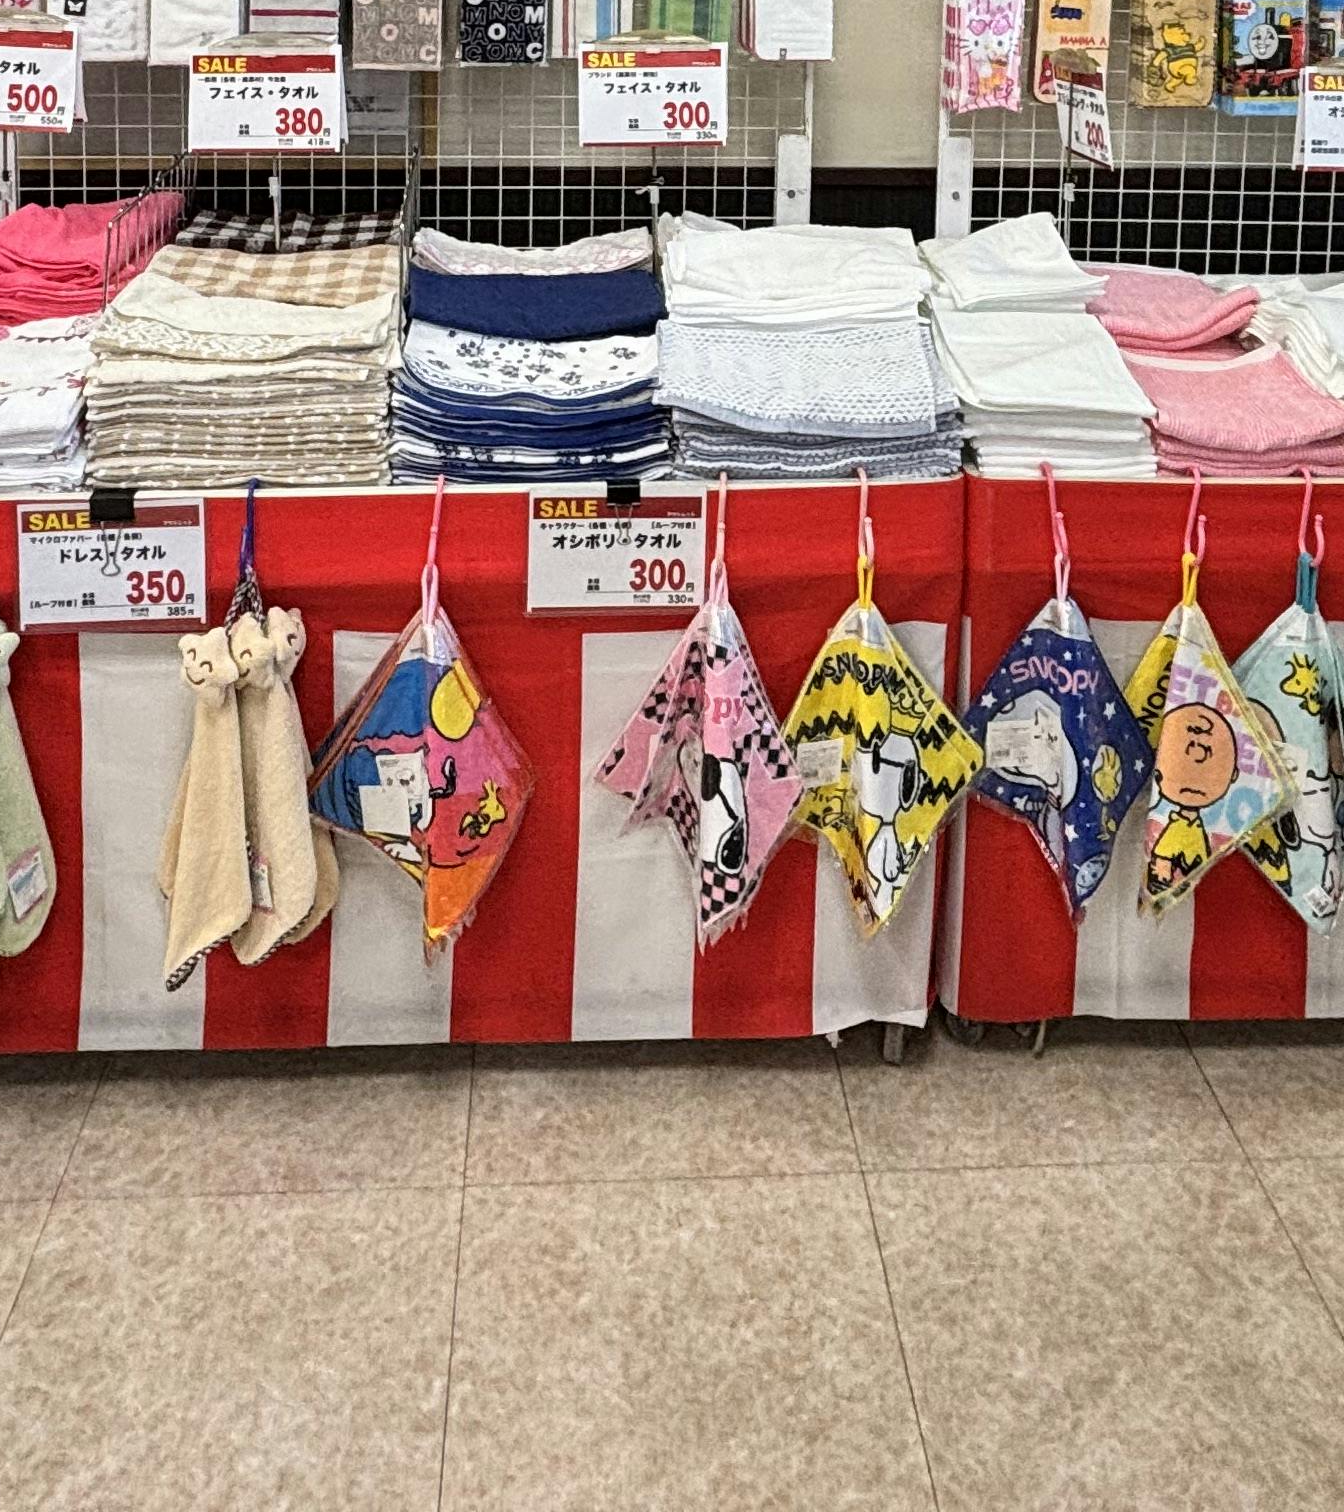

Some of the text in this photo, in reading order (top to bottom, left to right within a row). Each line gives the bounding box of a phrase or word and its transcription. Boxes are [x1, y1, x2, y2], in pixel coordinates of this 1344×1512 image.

[198, 57, 248, 72] SALE
[587, 53, 637, 67] SALE
[209, 86, 319, 99] フェイス・タオル
[604, 81, 701, 94] フェイス・タオル
[539, 500, 598, 517] SALE
[28, 512, 91, 530] SALE
[540, 522, 584, 530] キャラクター
[59, 545, 167, 564] ドレス・タオル
[1011, 656, 1100, 696] SNOOPY
